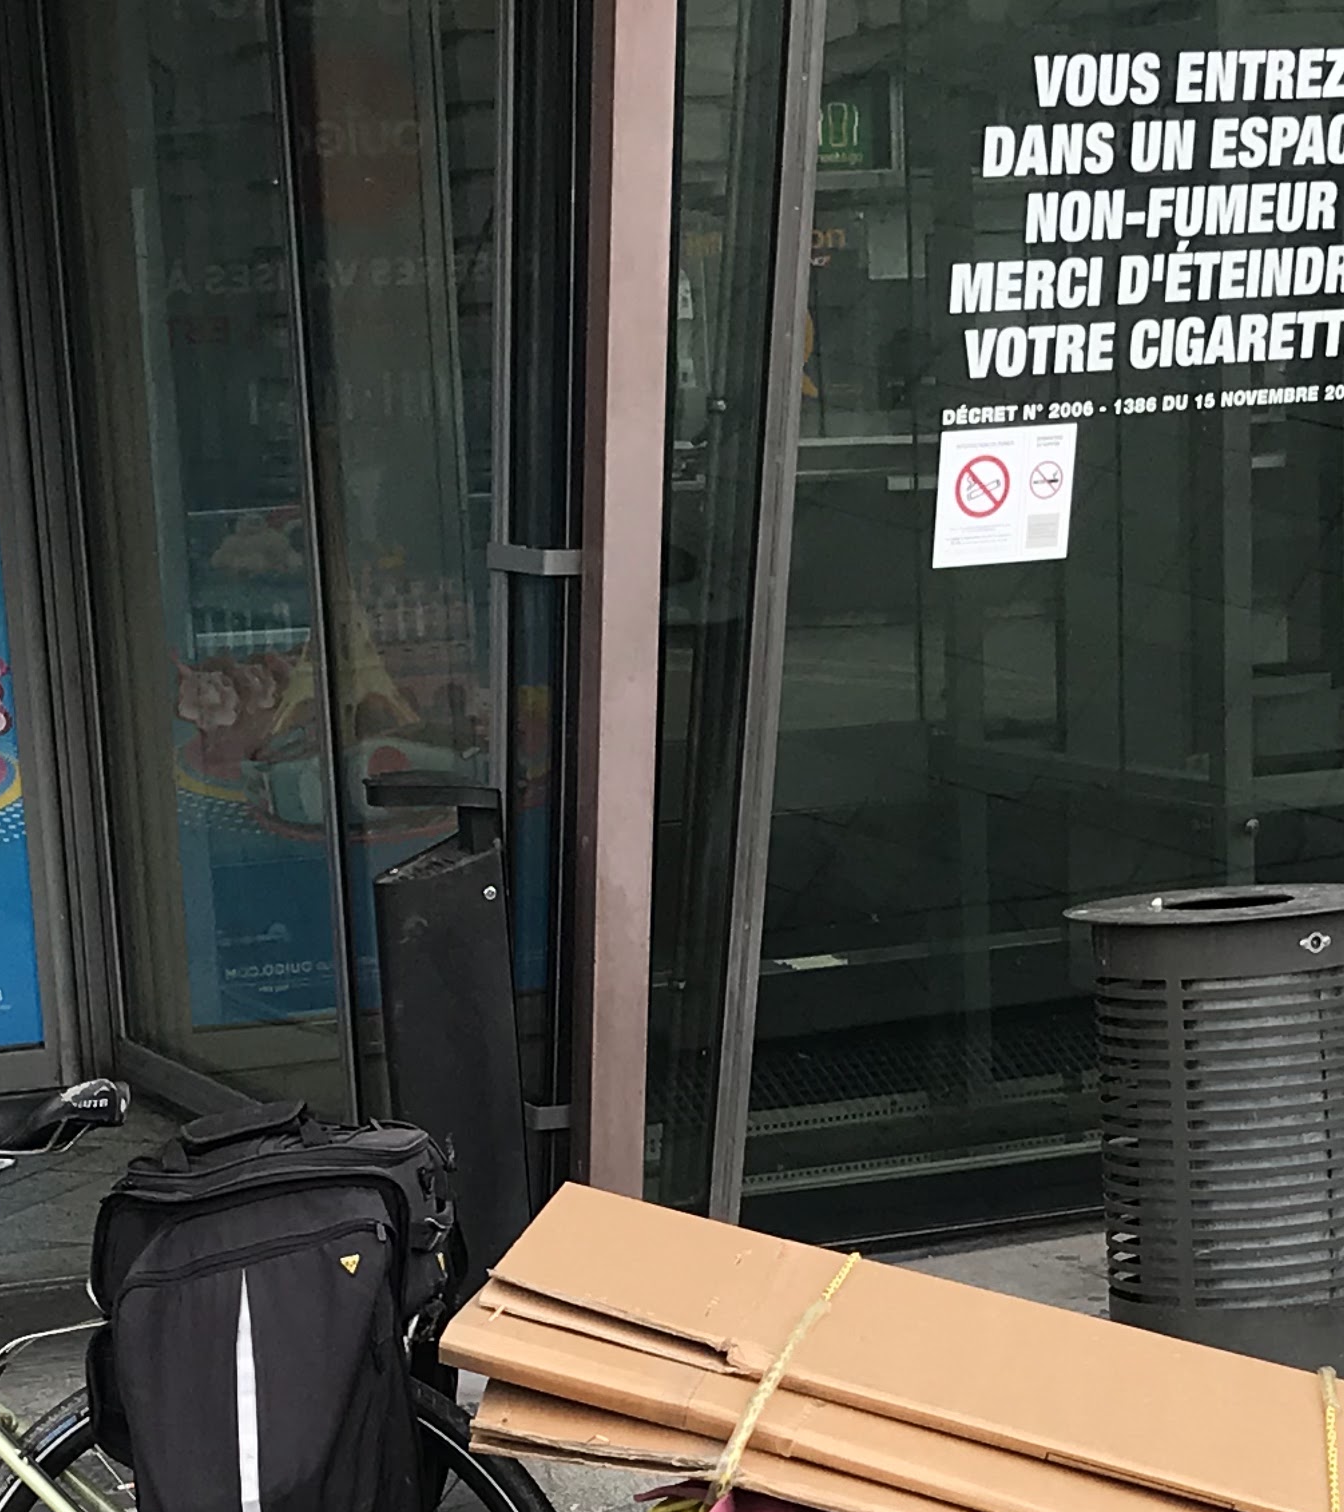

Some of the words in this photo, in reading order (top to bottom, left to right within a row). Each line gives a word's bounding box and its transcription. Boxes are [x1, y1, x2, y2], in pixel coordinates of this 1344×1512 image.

[1034, 54, 1160, 108] VOUS
[982, 122, 1114, 178] DANS
[1129, 119, 1195, 172] UN
[1024, 180, 1337, 244] NON-FUMEUR
[948, 256, 1104, 314] MERCI
[964, 321, 1116, 379] VOTRE
[942, 402, 1017, 426] DÉCRET
[1022, 402, 1045, 421] N°
[1048, 400, 1094, 420] 2006
[1114, 397, 1157, 416] 1386
[1162, 393, 1189, 412] DU
[1195, 391, 1215, 409] 15
[1221, 385, 1319, 408] NOVEMBRE
